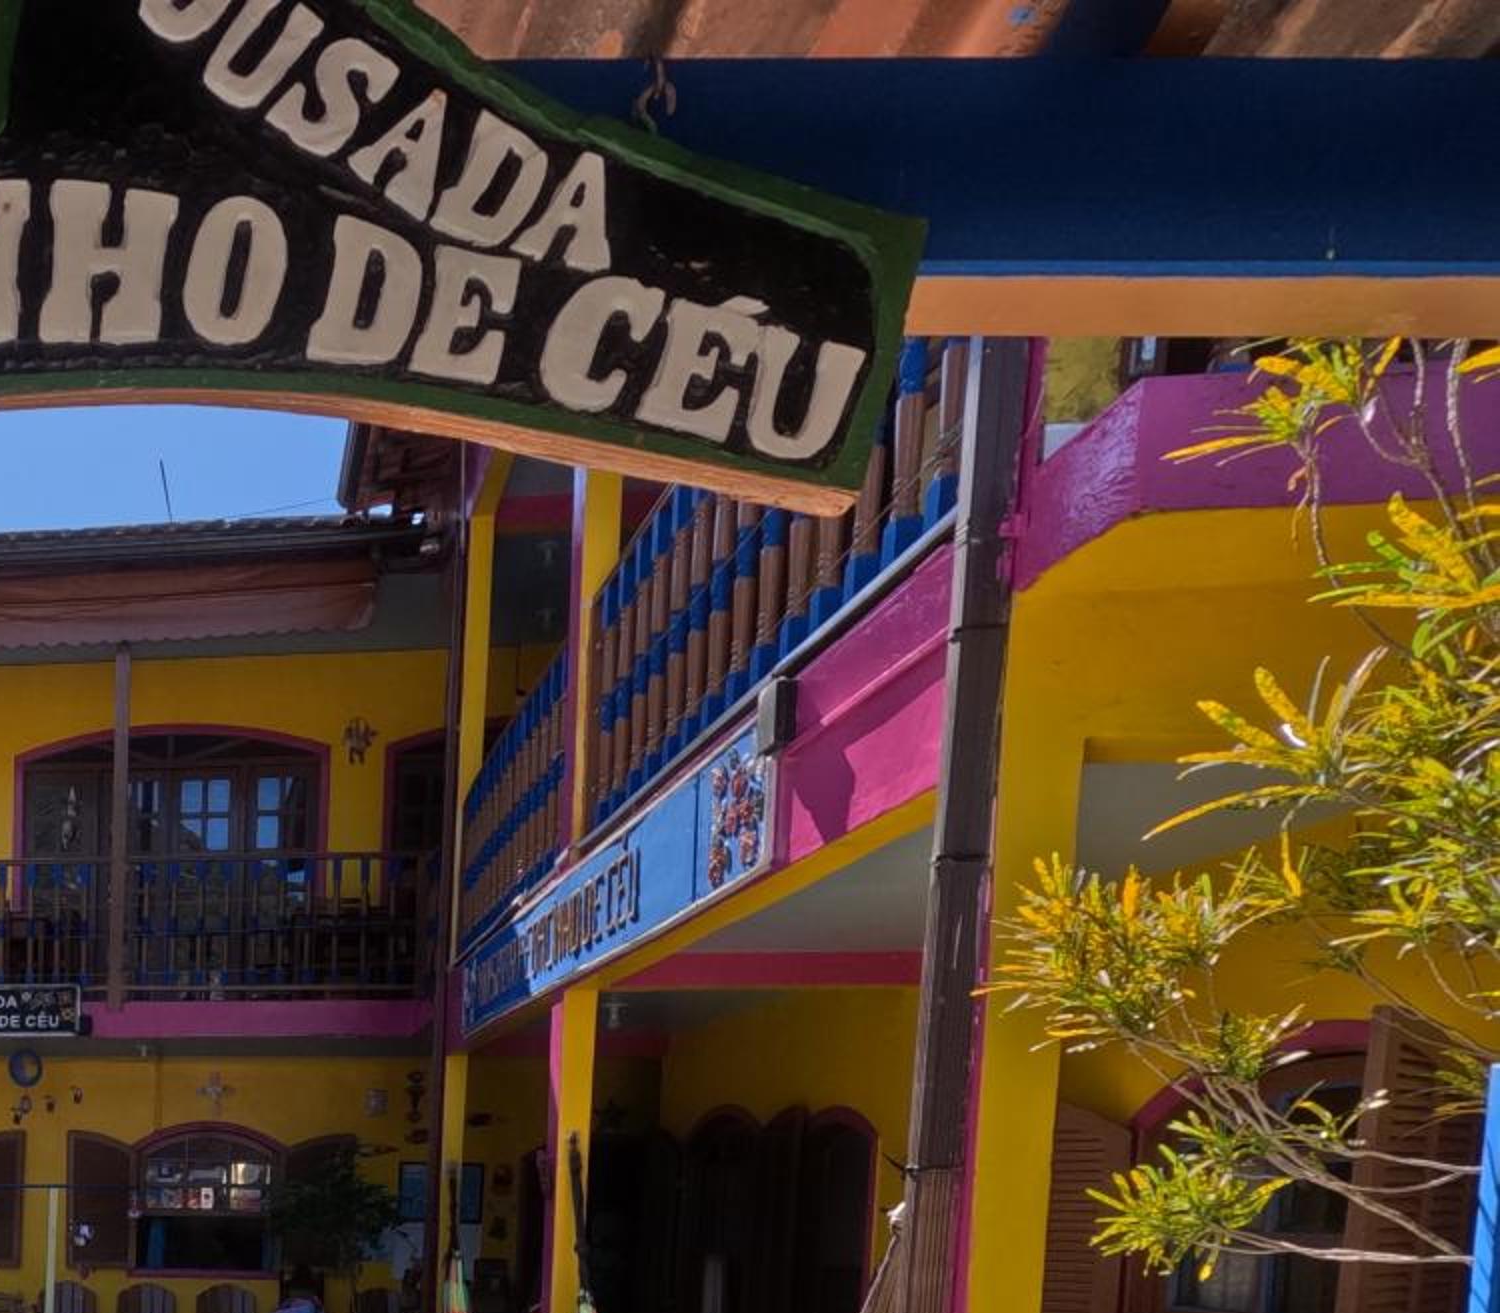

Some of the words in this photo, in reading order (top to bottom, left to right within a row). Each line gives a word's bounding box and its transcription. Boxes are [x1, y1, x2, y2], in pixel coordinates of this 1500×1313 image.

[307, 214, 521, 386] DE
[540, 275, 866, 460] CÉU
[25, 1010, 59, 1028] CÉU
